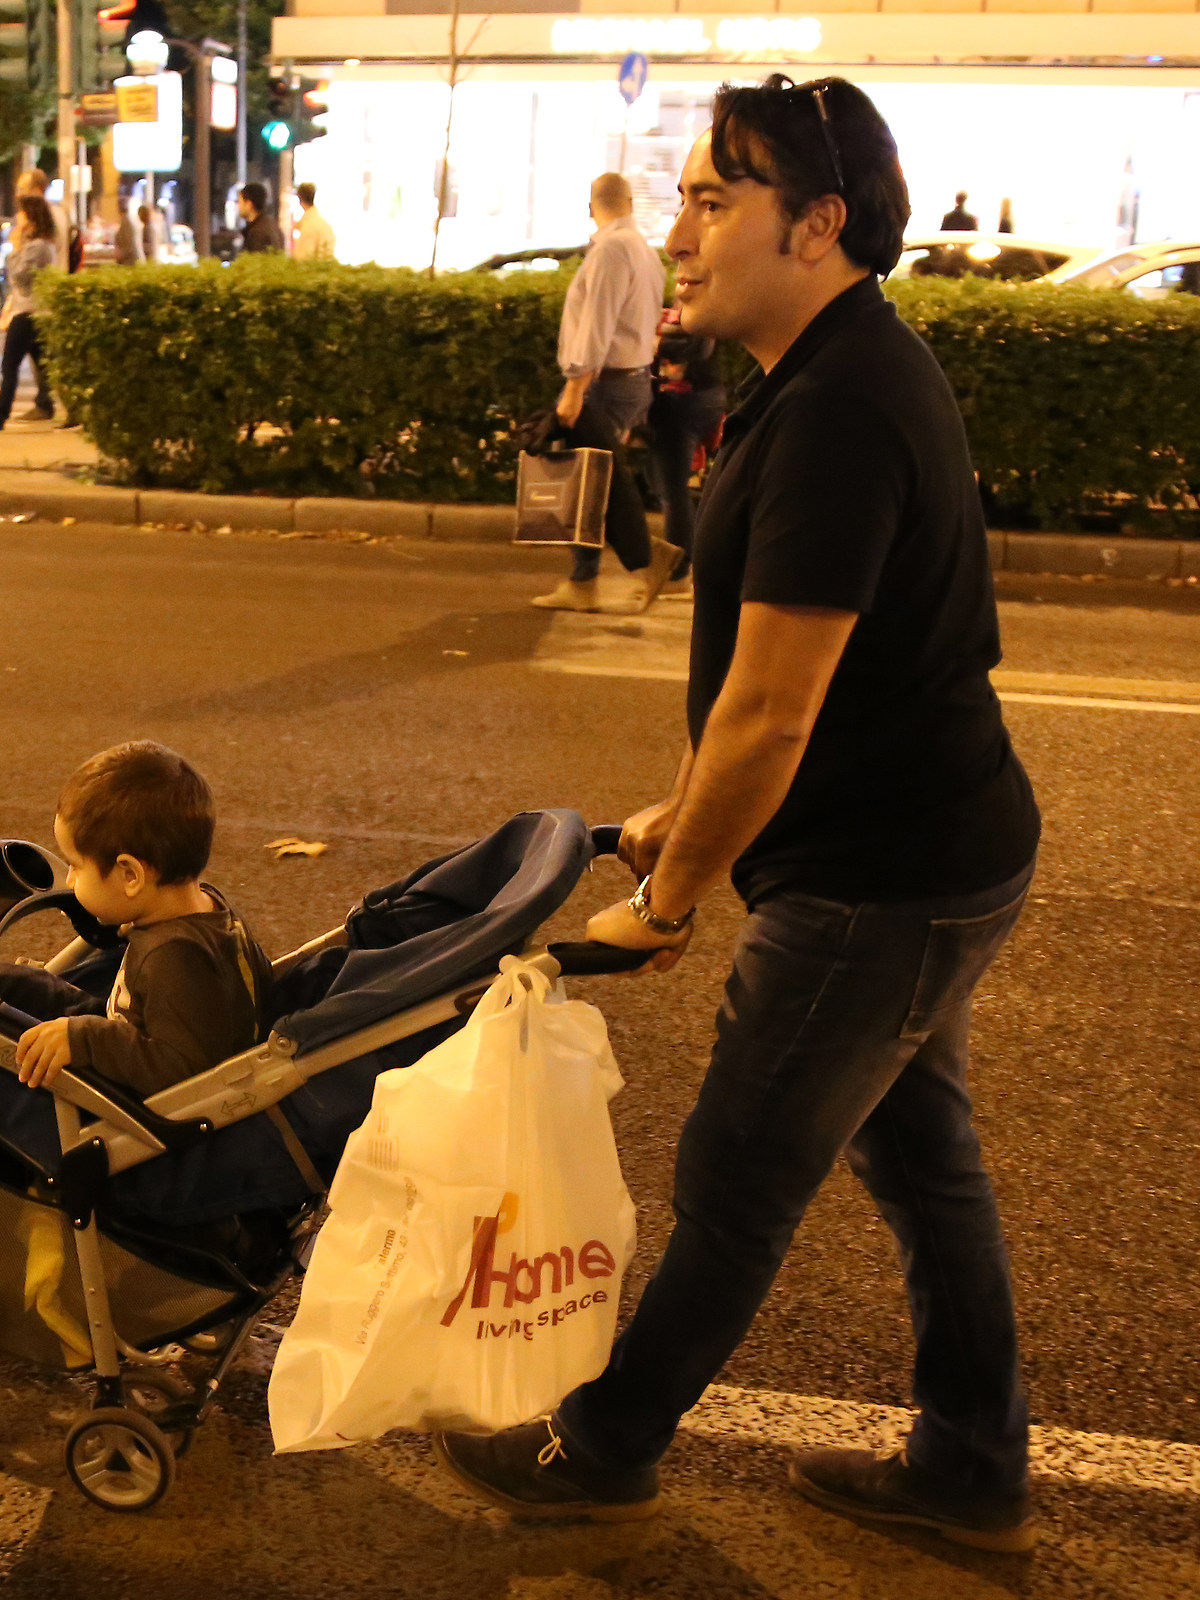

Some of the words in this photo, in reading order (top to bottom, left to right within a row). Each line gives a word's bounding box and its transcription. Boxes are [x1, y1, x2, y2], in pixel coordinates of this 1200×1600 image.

[374, 1229, 396, 1270] alermo
[440, 1214, 616, 1327] Home
[537, 1290, 608, 1326] space
[355, 1330, 368, 1345] Via
